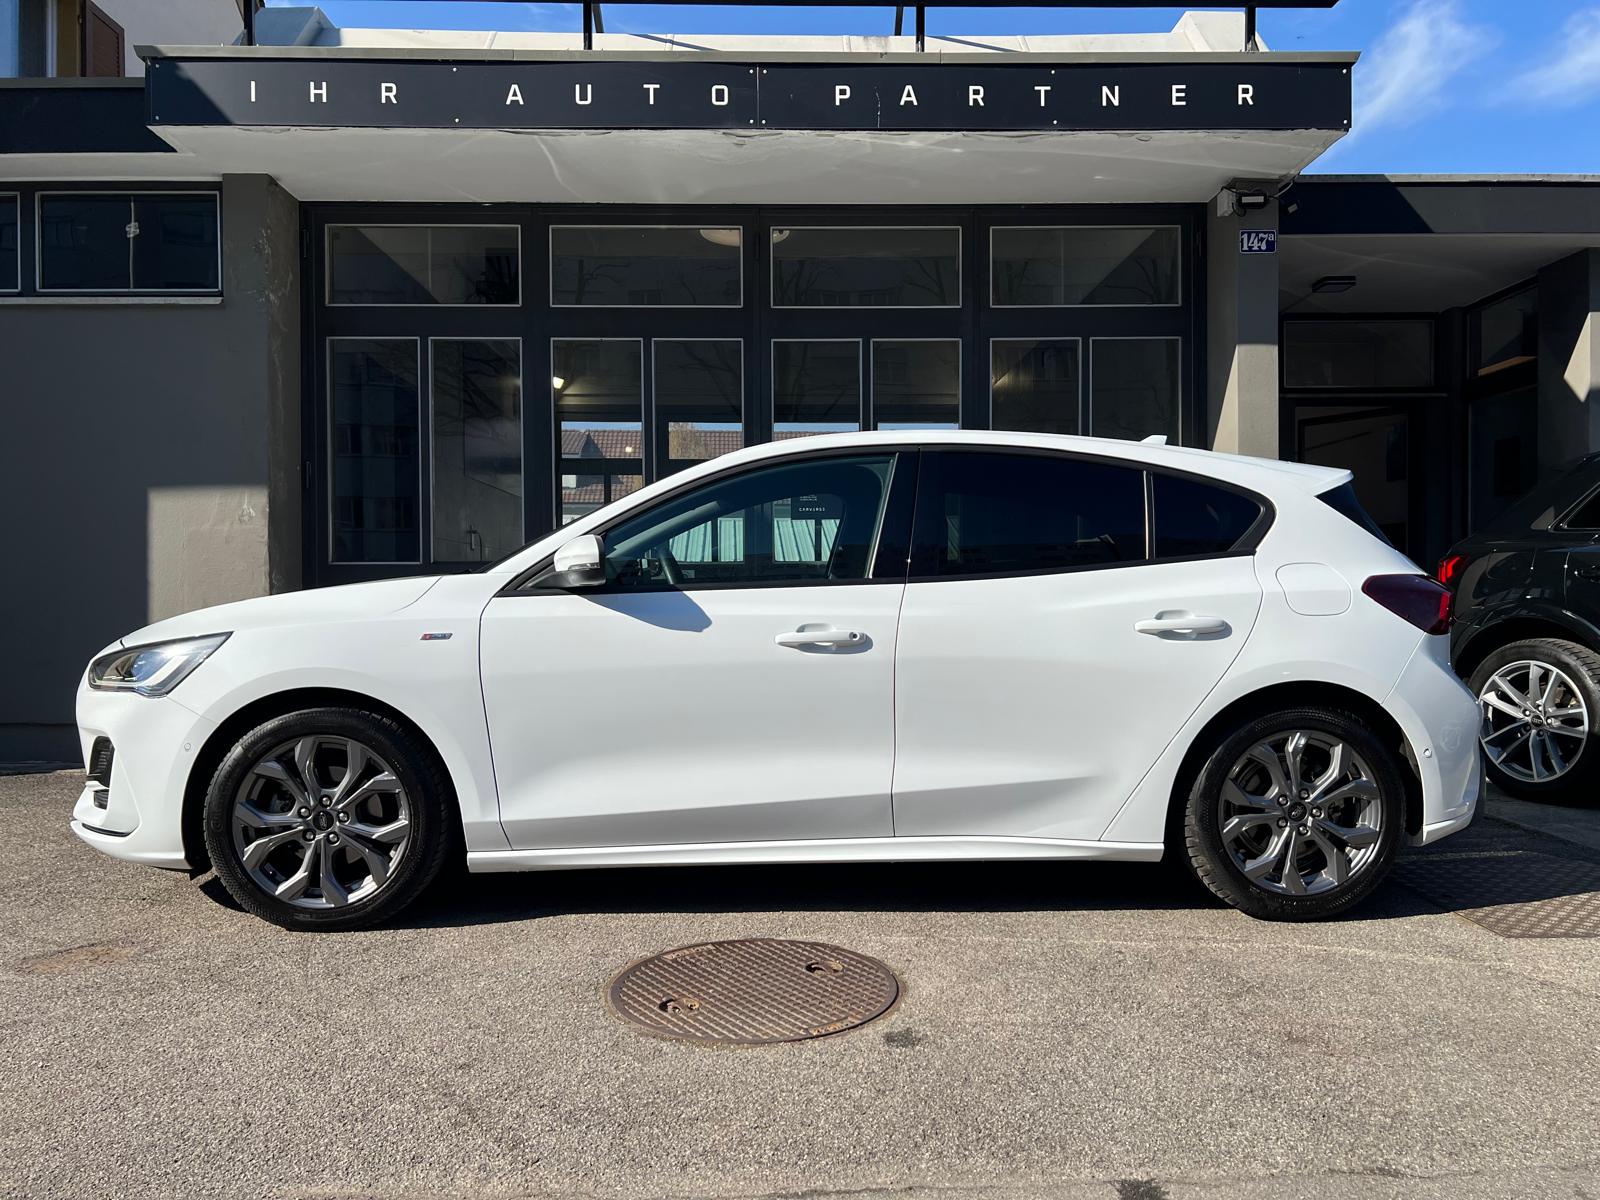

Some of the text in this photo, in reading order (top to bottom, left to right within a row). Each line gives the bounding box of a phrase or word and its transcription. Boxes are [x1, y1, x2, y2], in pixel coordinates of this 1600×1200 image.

[250, 80, 1254, 107] IHR AUTO PARTNER
[1241, 232, 1275, 251] 147a
